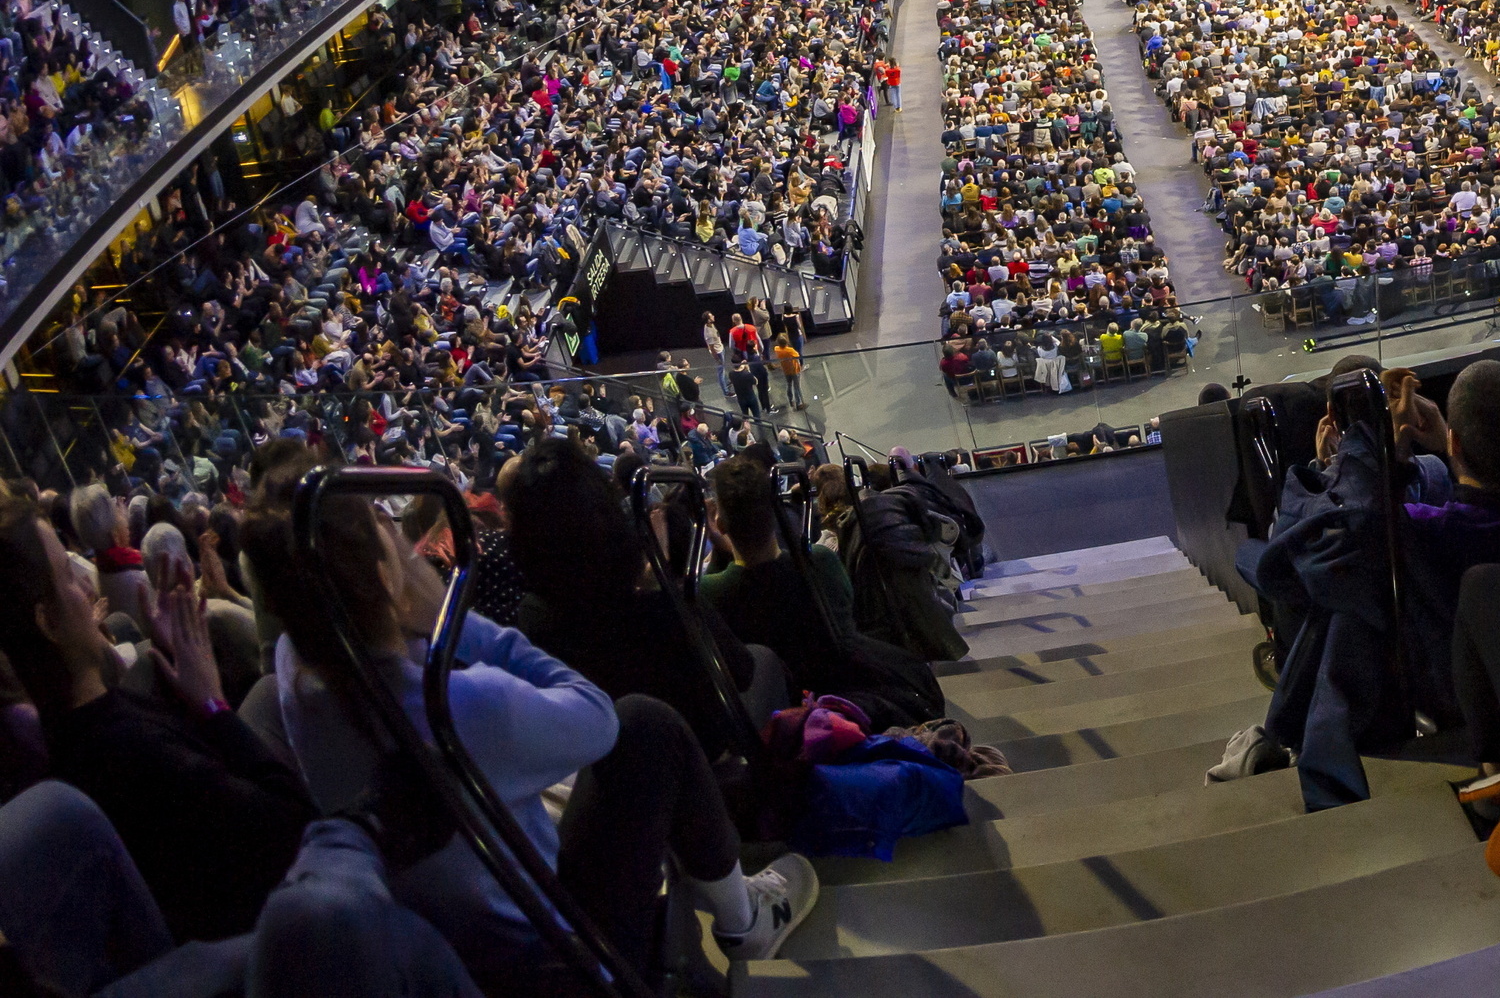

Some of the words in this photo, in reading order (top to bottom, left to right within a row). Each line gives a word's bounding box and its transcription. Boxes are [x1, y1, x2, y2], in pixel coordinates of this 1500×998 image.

[587, 249, 604, 286] SALIDA
[591, 258, 610, 301] IRTEERA
[772, 897, 792, 929] N
